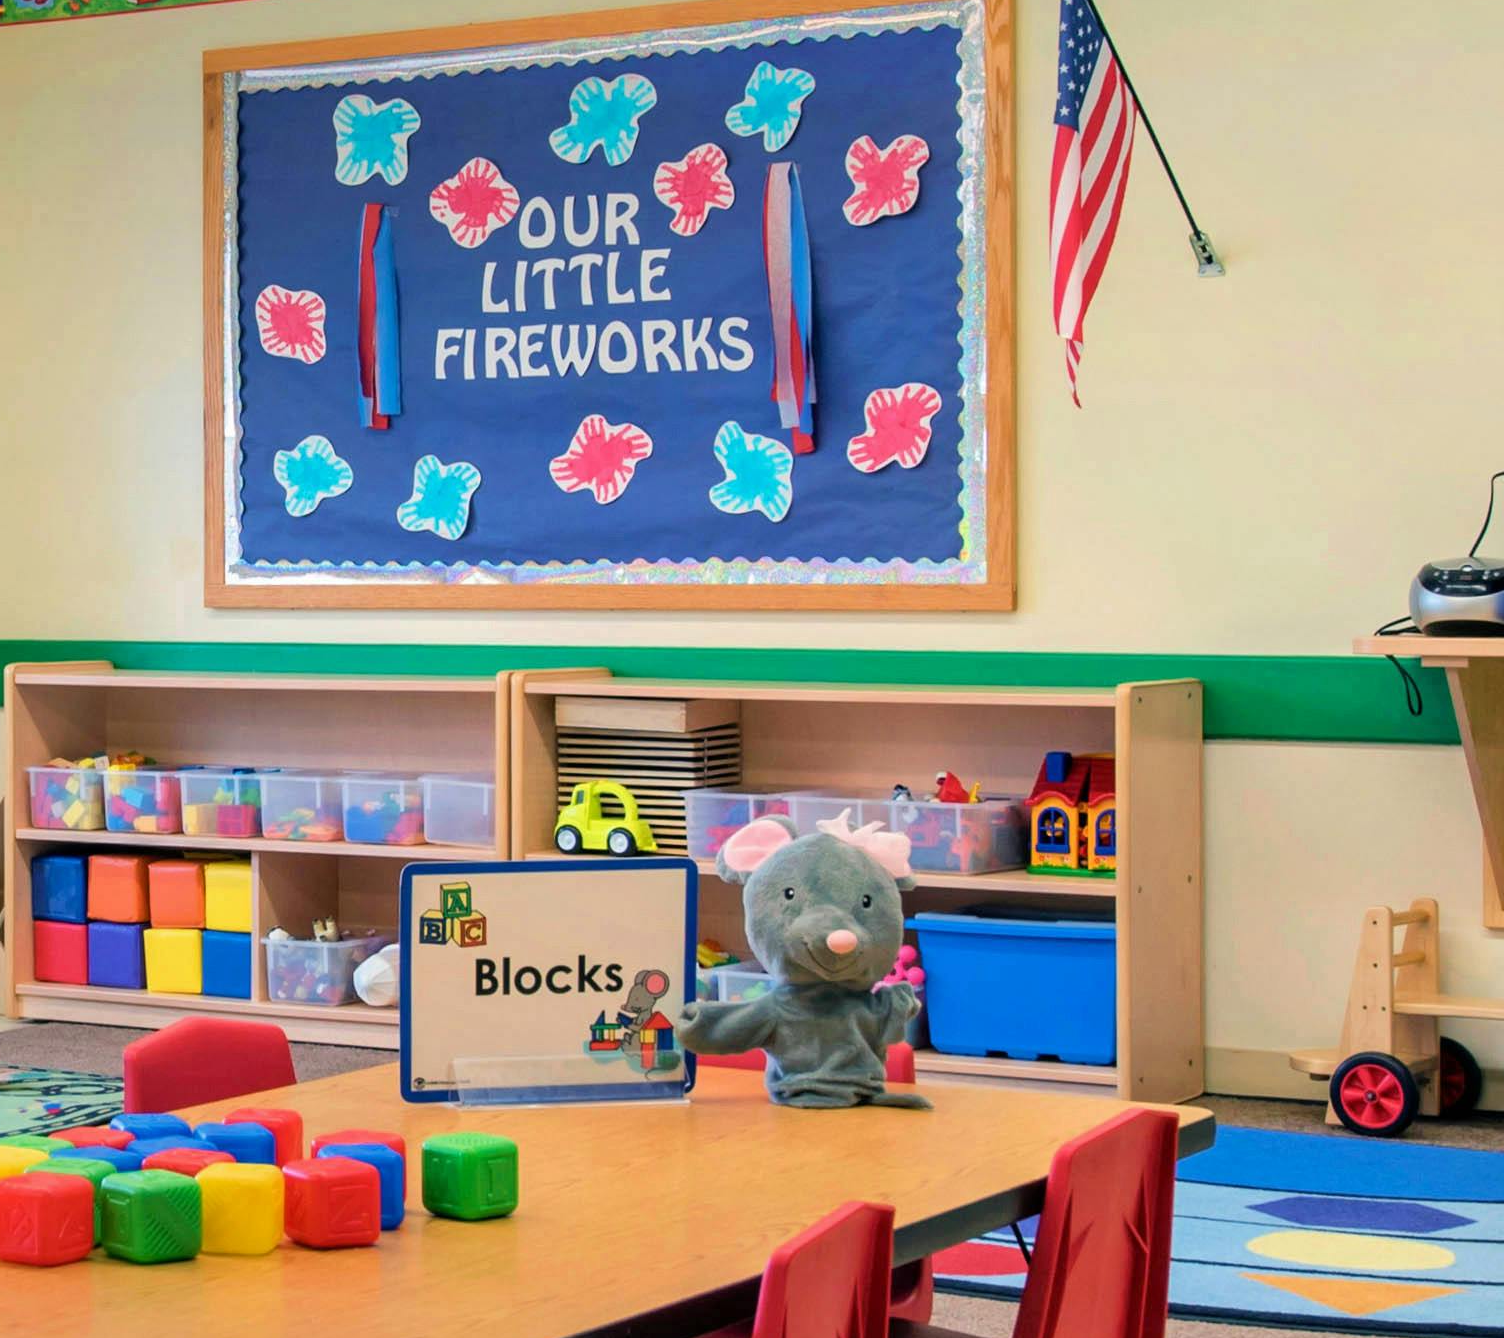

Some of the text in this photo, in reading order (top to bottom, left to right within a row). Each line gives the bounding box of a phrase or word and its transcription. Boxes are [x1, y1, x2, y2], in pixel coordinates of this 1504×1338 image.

[518, 192, 640, 250] OUR
[481, 248, 672, 314] LITTLE
[435, 316, 755, 380] FIREWORKS
[474, 954, 624, 998] Blocks
